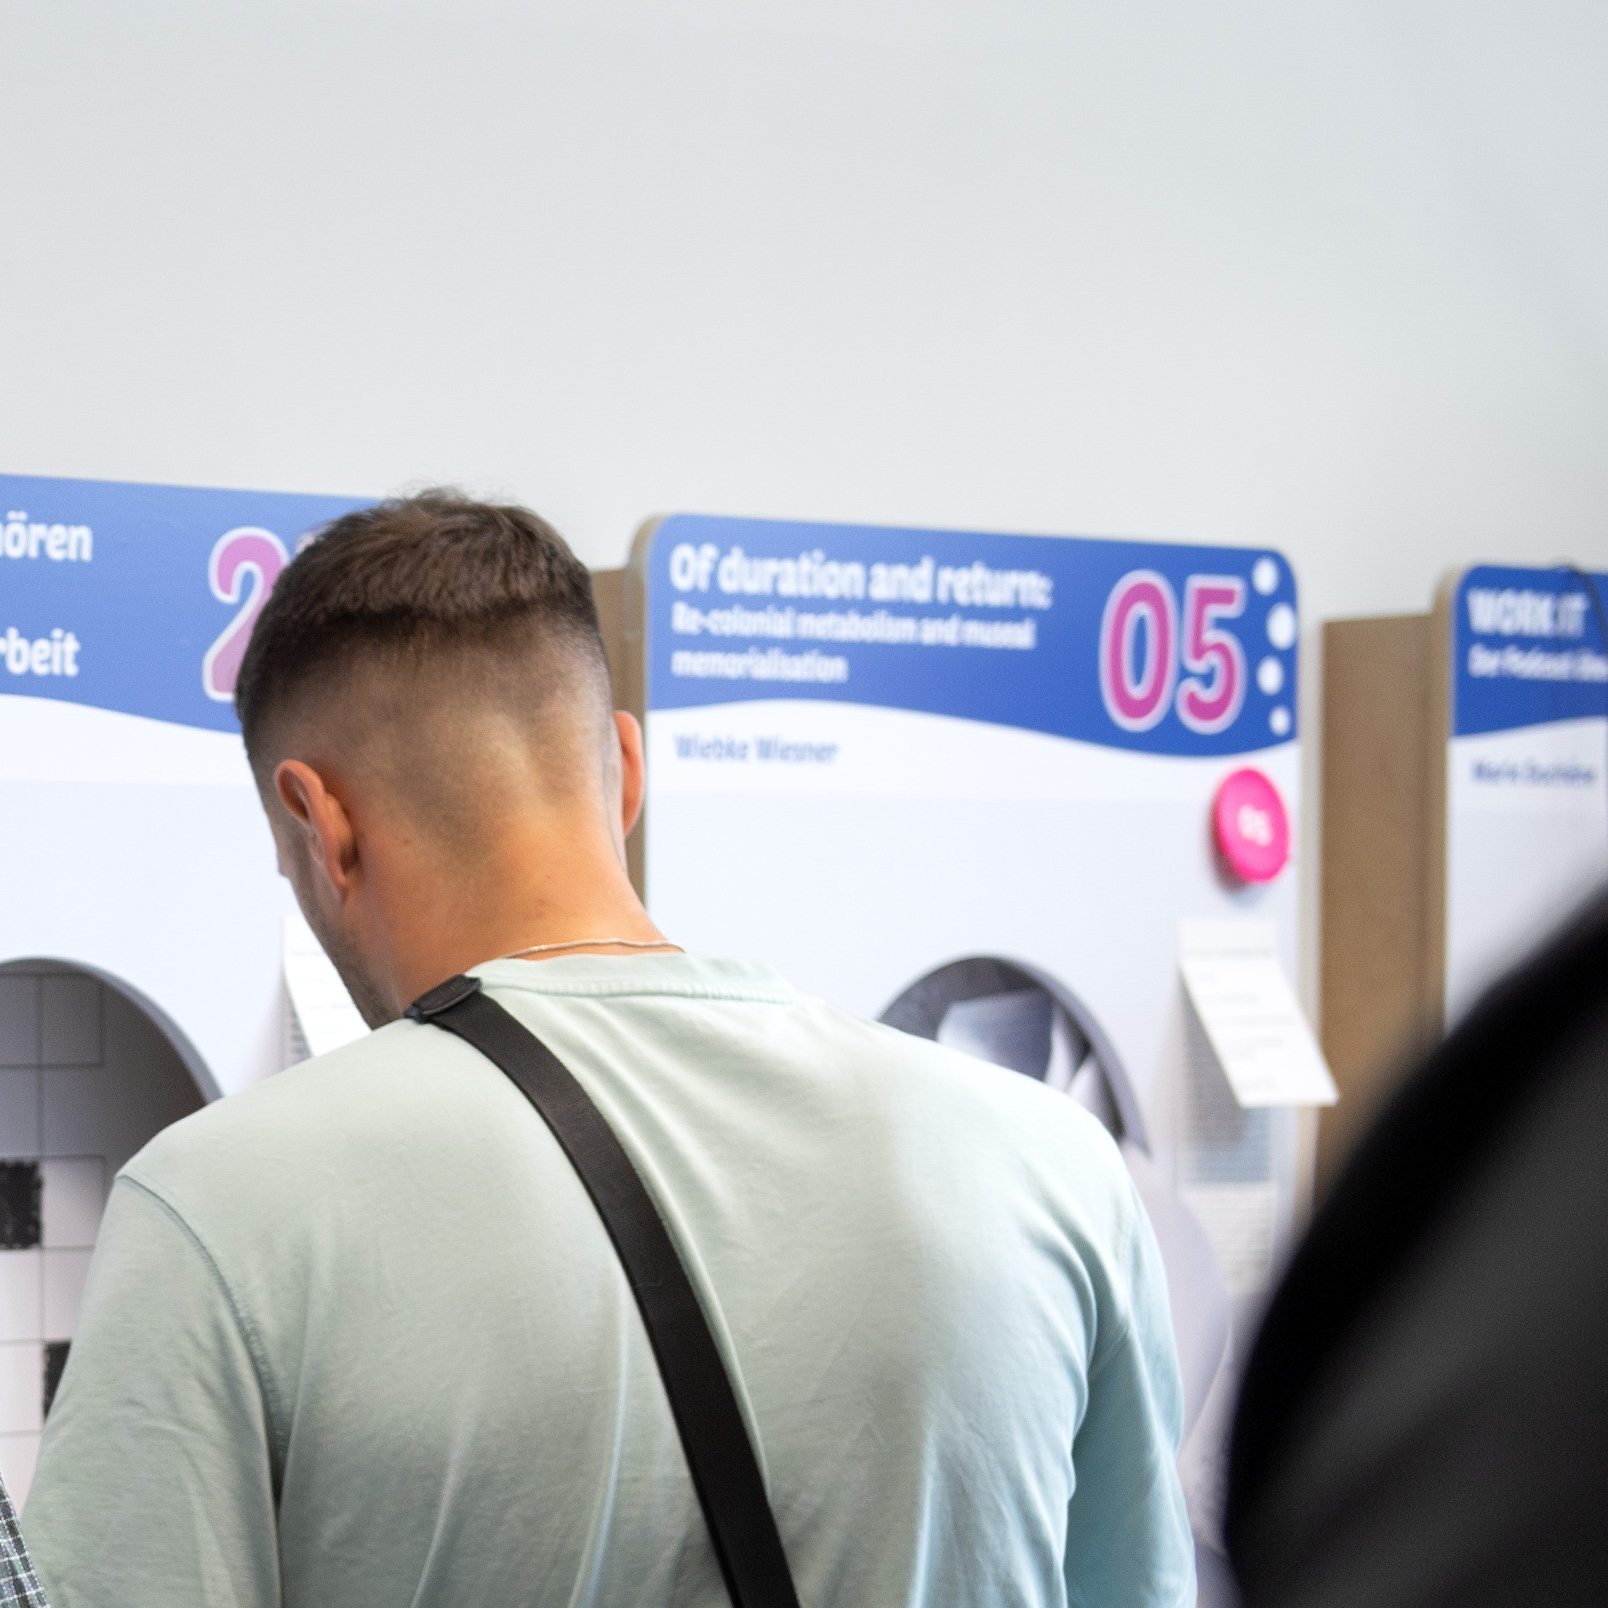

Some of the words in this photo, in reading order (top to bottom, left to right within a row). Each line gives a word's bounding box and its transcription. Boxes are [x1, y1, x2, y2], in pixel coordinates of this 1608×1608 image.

[669, 542, 719, 593] Of
[718, 546, 866, 601] duration
[868, 554, 935, 604] and
[937, 560, 1054, 611] return:
[797, 608, 917, 645] metabolism
[919, 613, 961, 647] and
[671, 645, 850, 684] memorialisation
[1098, 567, 1248, 736] 05
[673, 732, 750, 762] Wiebke
[754, 734, 839, 765] Wiesner
